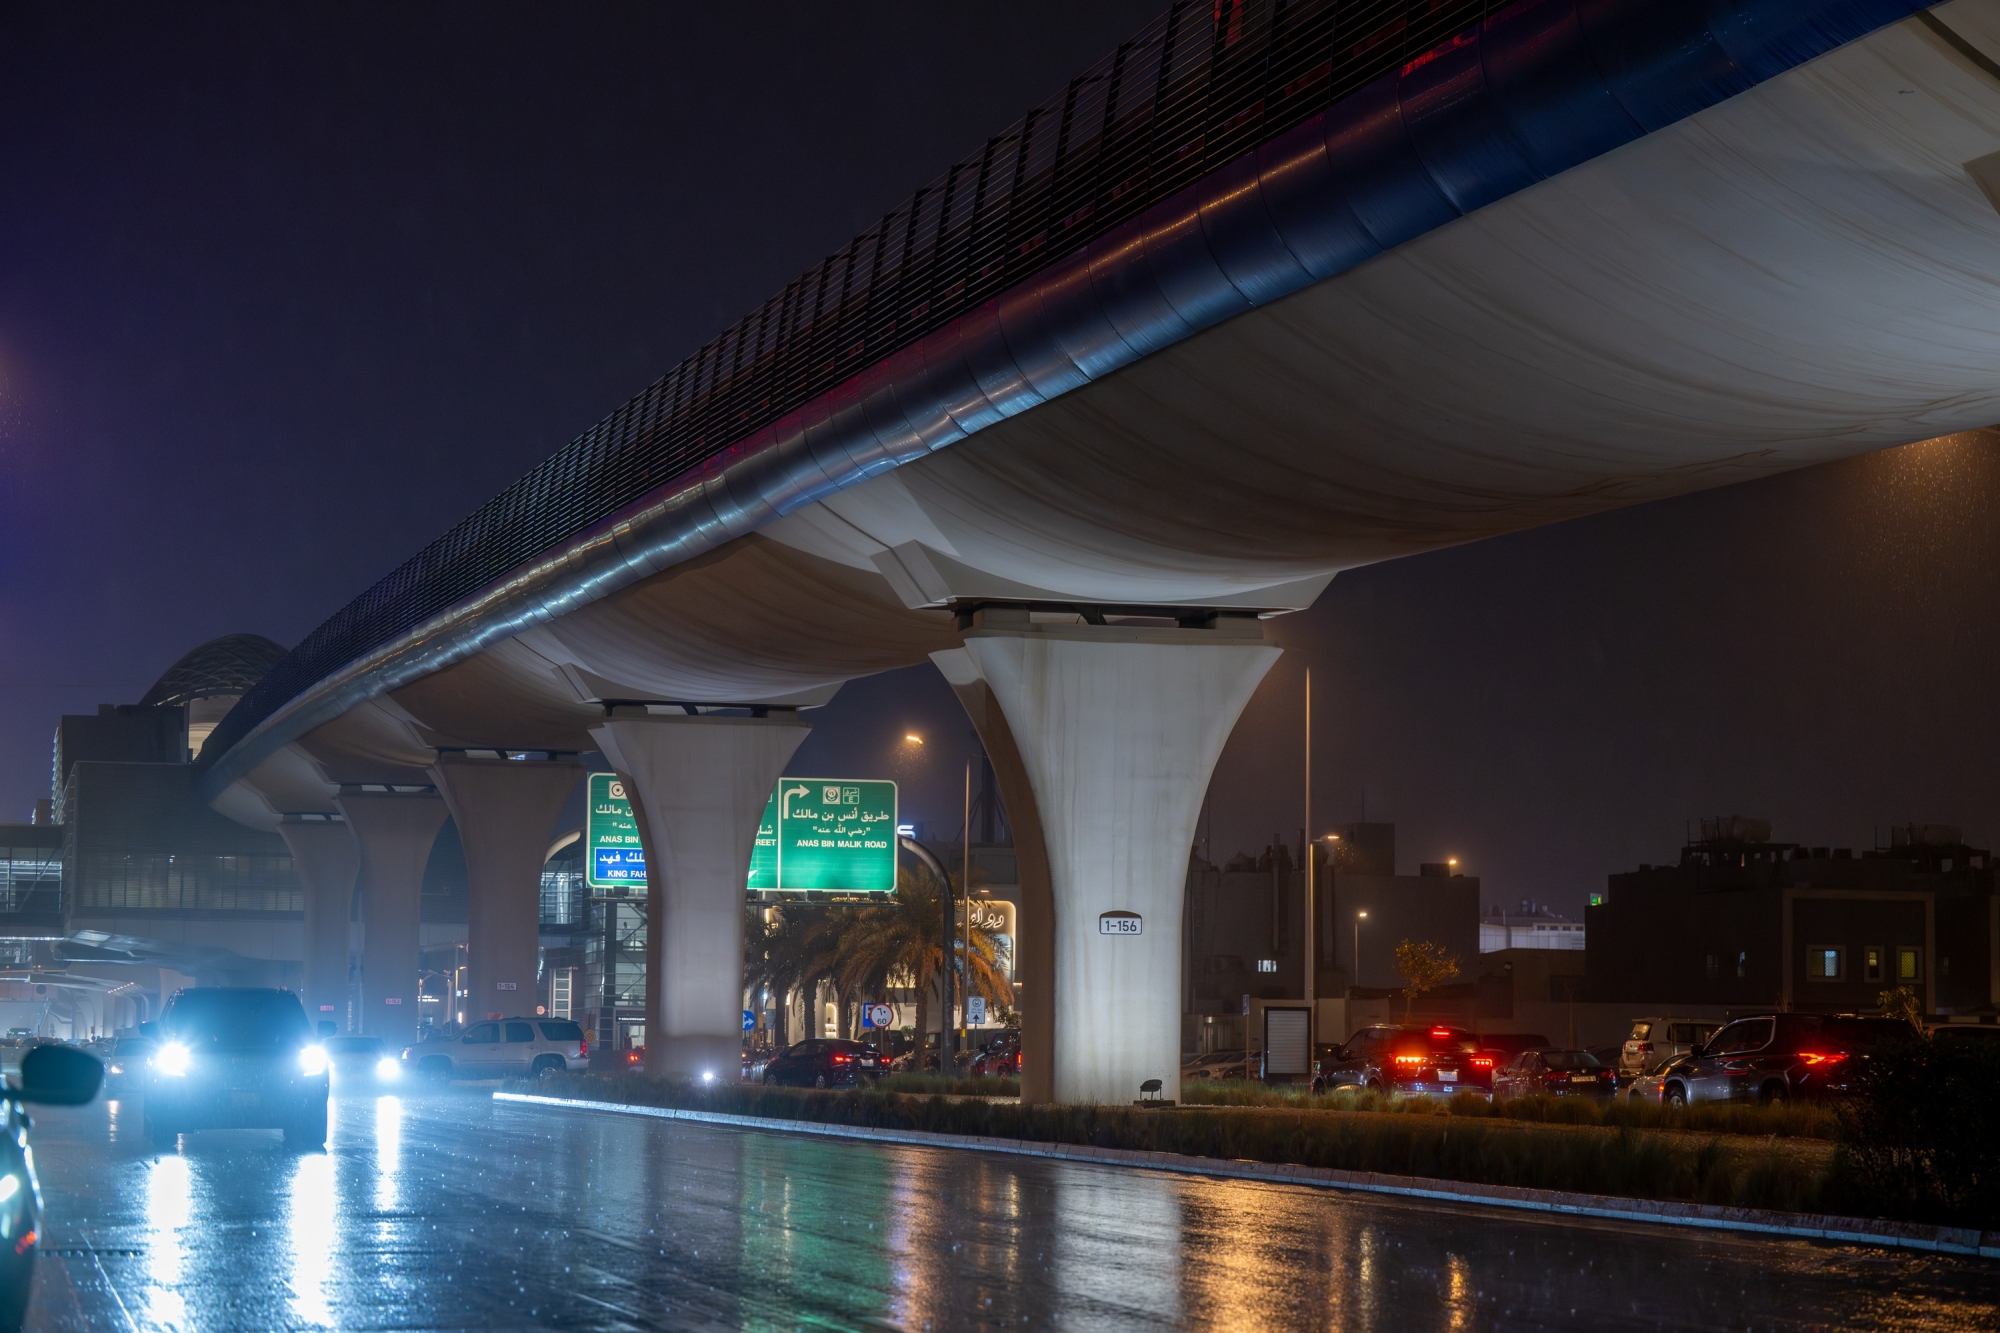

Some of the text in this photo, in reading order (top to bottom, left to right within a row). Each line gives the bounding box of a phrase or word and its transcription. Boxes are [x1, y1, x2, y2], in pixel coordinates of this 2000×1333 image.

[595, 804, 622, 814] مالك
[792, 806, 890, 822] طريق أنس بن مالك
[756, 824, 774, 837] شار
[833, 822, 846, 834] الله
[599, 835, 639, 844] ANAS BIN
[755, 838, 777, 847] REET
[796, 839, 888, 849] ANAS BIN MALIK ROAD
[599, 851, 621, 865] فهد
[607, 869, 648, 878] KING FAH
[1104, 919, 1138, 932] 1-156
[876, 1007, 887, 1016] ٦٠
[876, 1017, 887, 1025] 60
